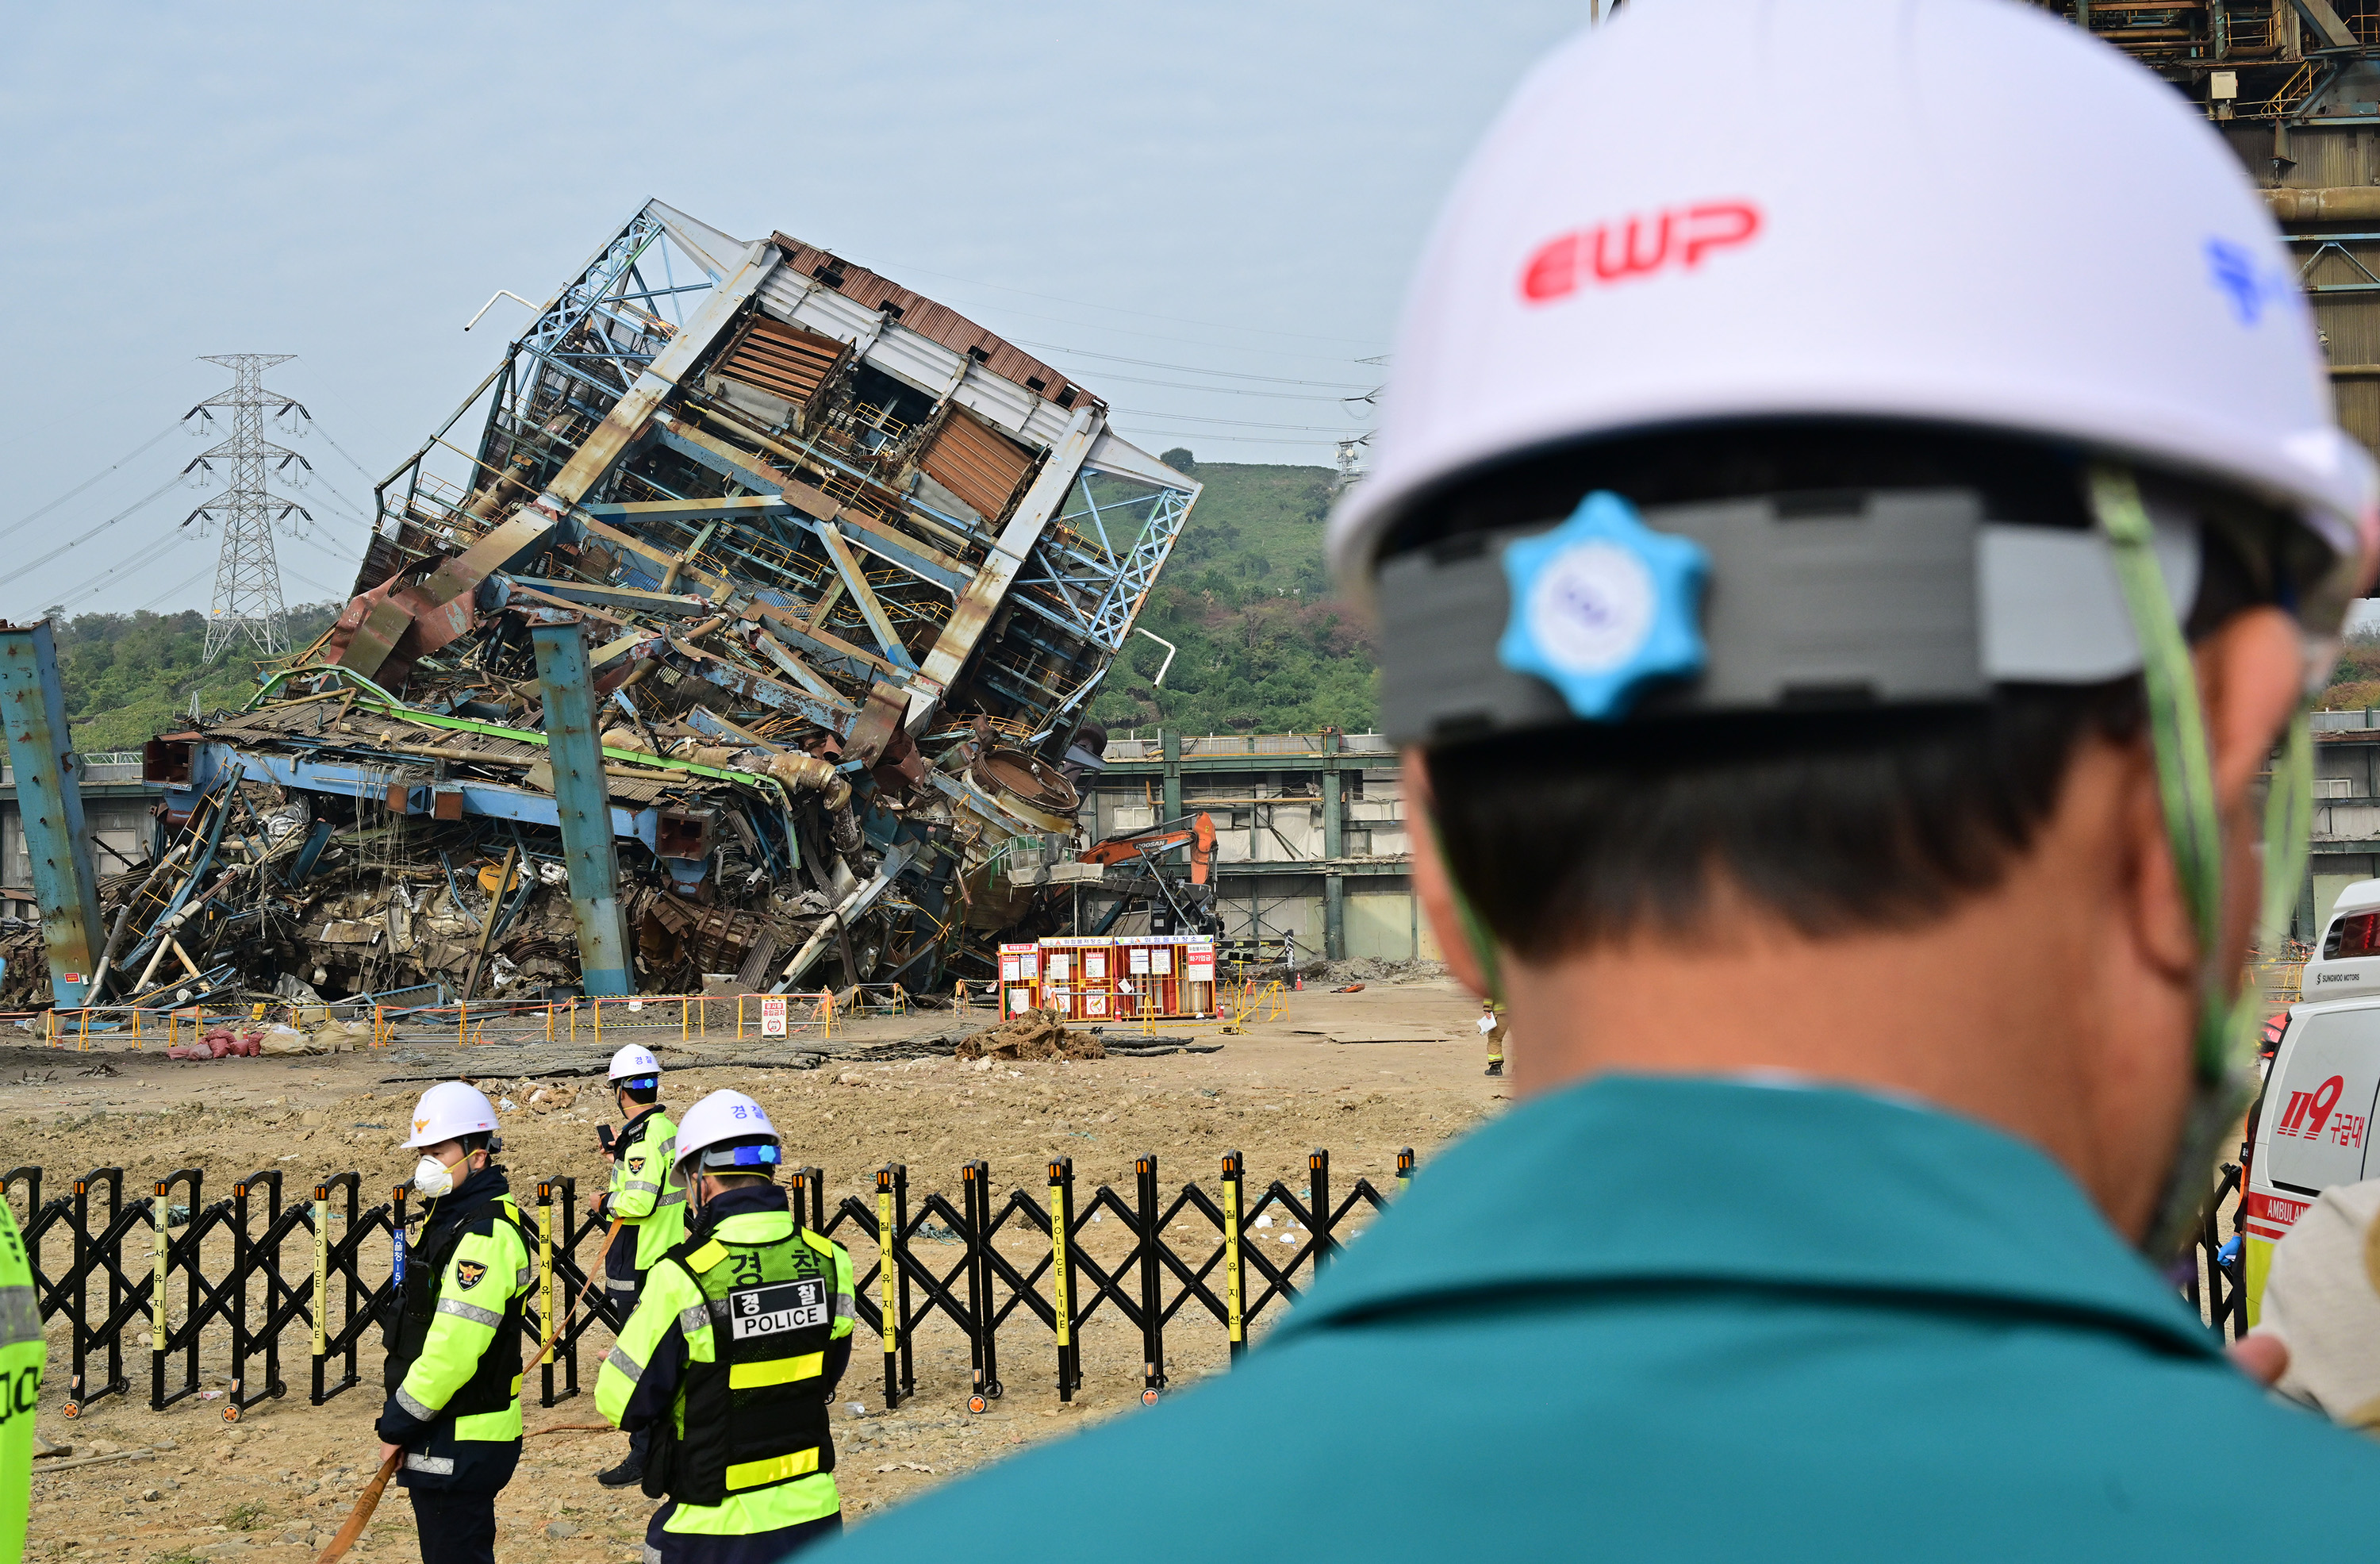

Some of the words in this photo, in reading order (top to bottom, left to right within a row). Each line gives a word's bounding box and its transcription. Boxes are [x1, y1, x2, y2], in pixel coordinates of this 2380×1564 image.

[1521, 202, 1760, 299] EWP
[2277, 1075, 2344, 1140] 119
[2331, 1112, 2365, 1148] 구급대
[394, 1232, 403, 1286] 서울청-5
[1054, 1215, 1063, 1277] POLICE
[744, 1307, 818, 1335] POLICE
